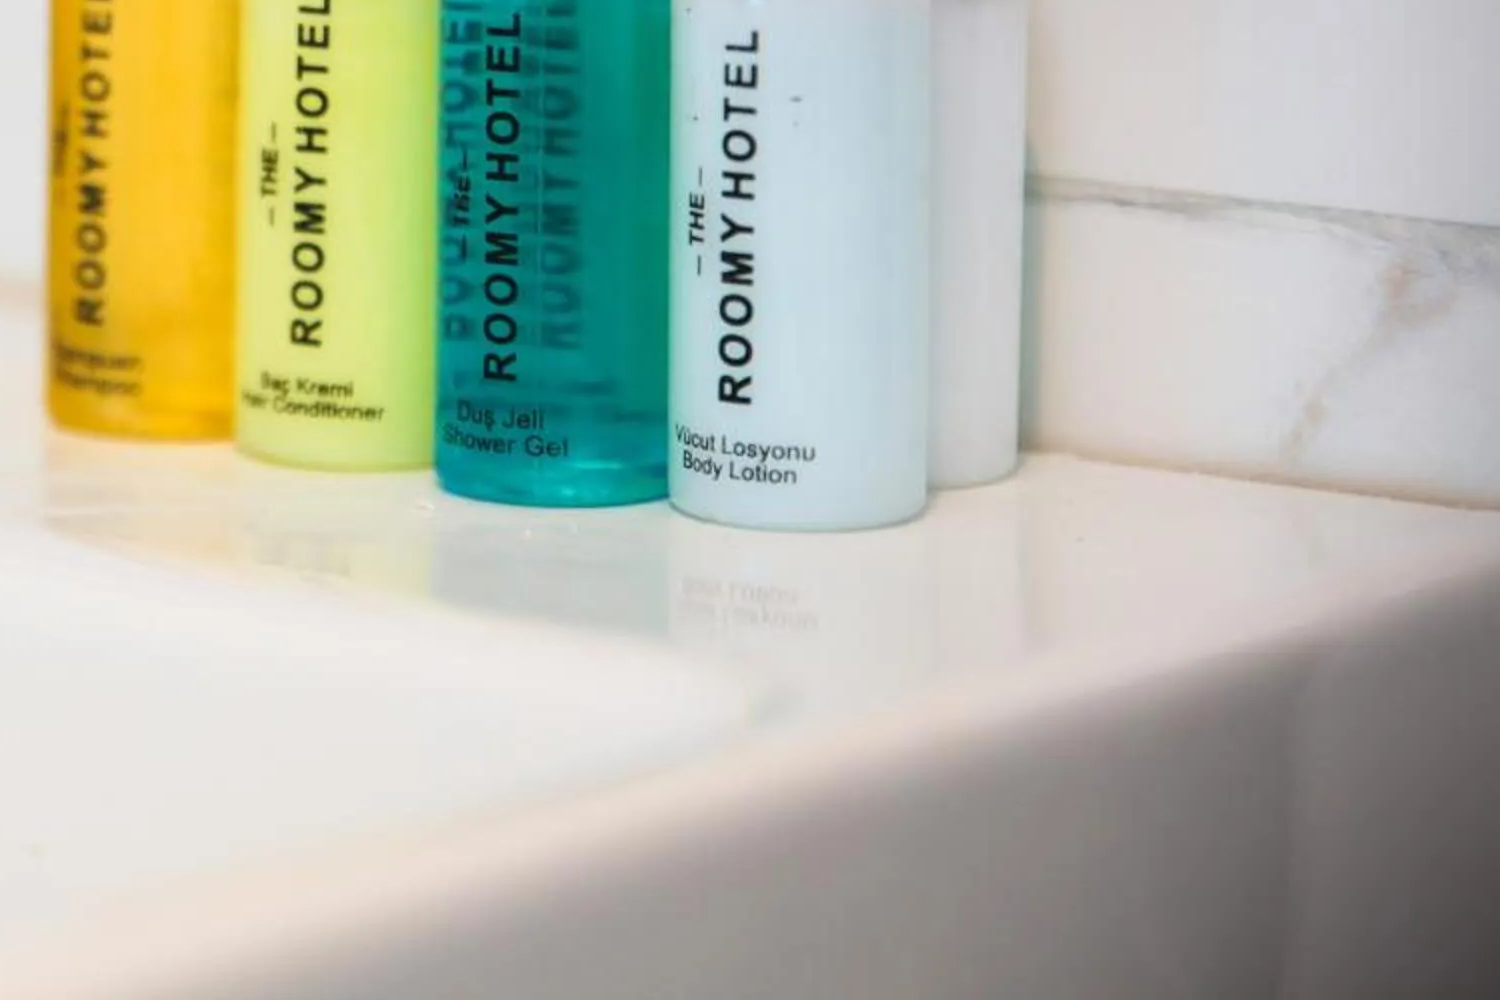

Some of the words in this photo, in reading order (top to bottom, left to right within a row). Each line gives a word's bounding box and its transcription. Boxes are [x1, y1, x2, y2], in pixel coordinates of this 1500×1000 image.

[485, 12, 522, 182] HOTEL
[721, 30, 759, 201] HOTEL
[261, 148, 278, 198] THE
[73, 151, 108, 327] ROOMY
[688, 191, 706, 246] THE
[290, 166, 328, 348] ROOMY
[483, 194, 519, 382] ROOMY
[718, 213, 754, 405] ROOMY
[273, 396, 385, 421] Conditioner
[457, 399, 496, 432] Duş
[443, 421, 516, 455] Shower
[525, 434, 569, 457] Gel
[675, 423, 716, 451] Vücut
[722, 434, 816, 463] Losyonu
[683, 449, 723, 481] Body
[729, 460, 798, 484] Lotion
